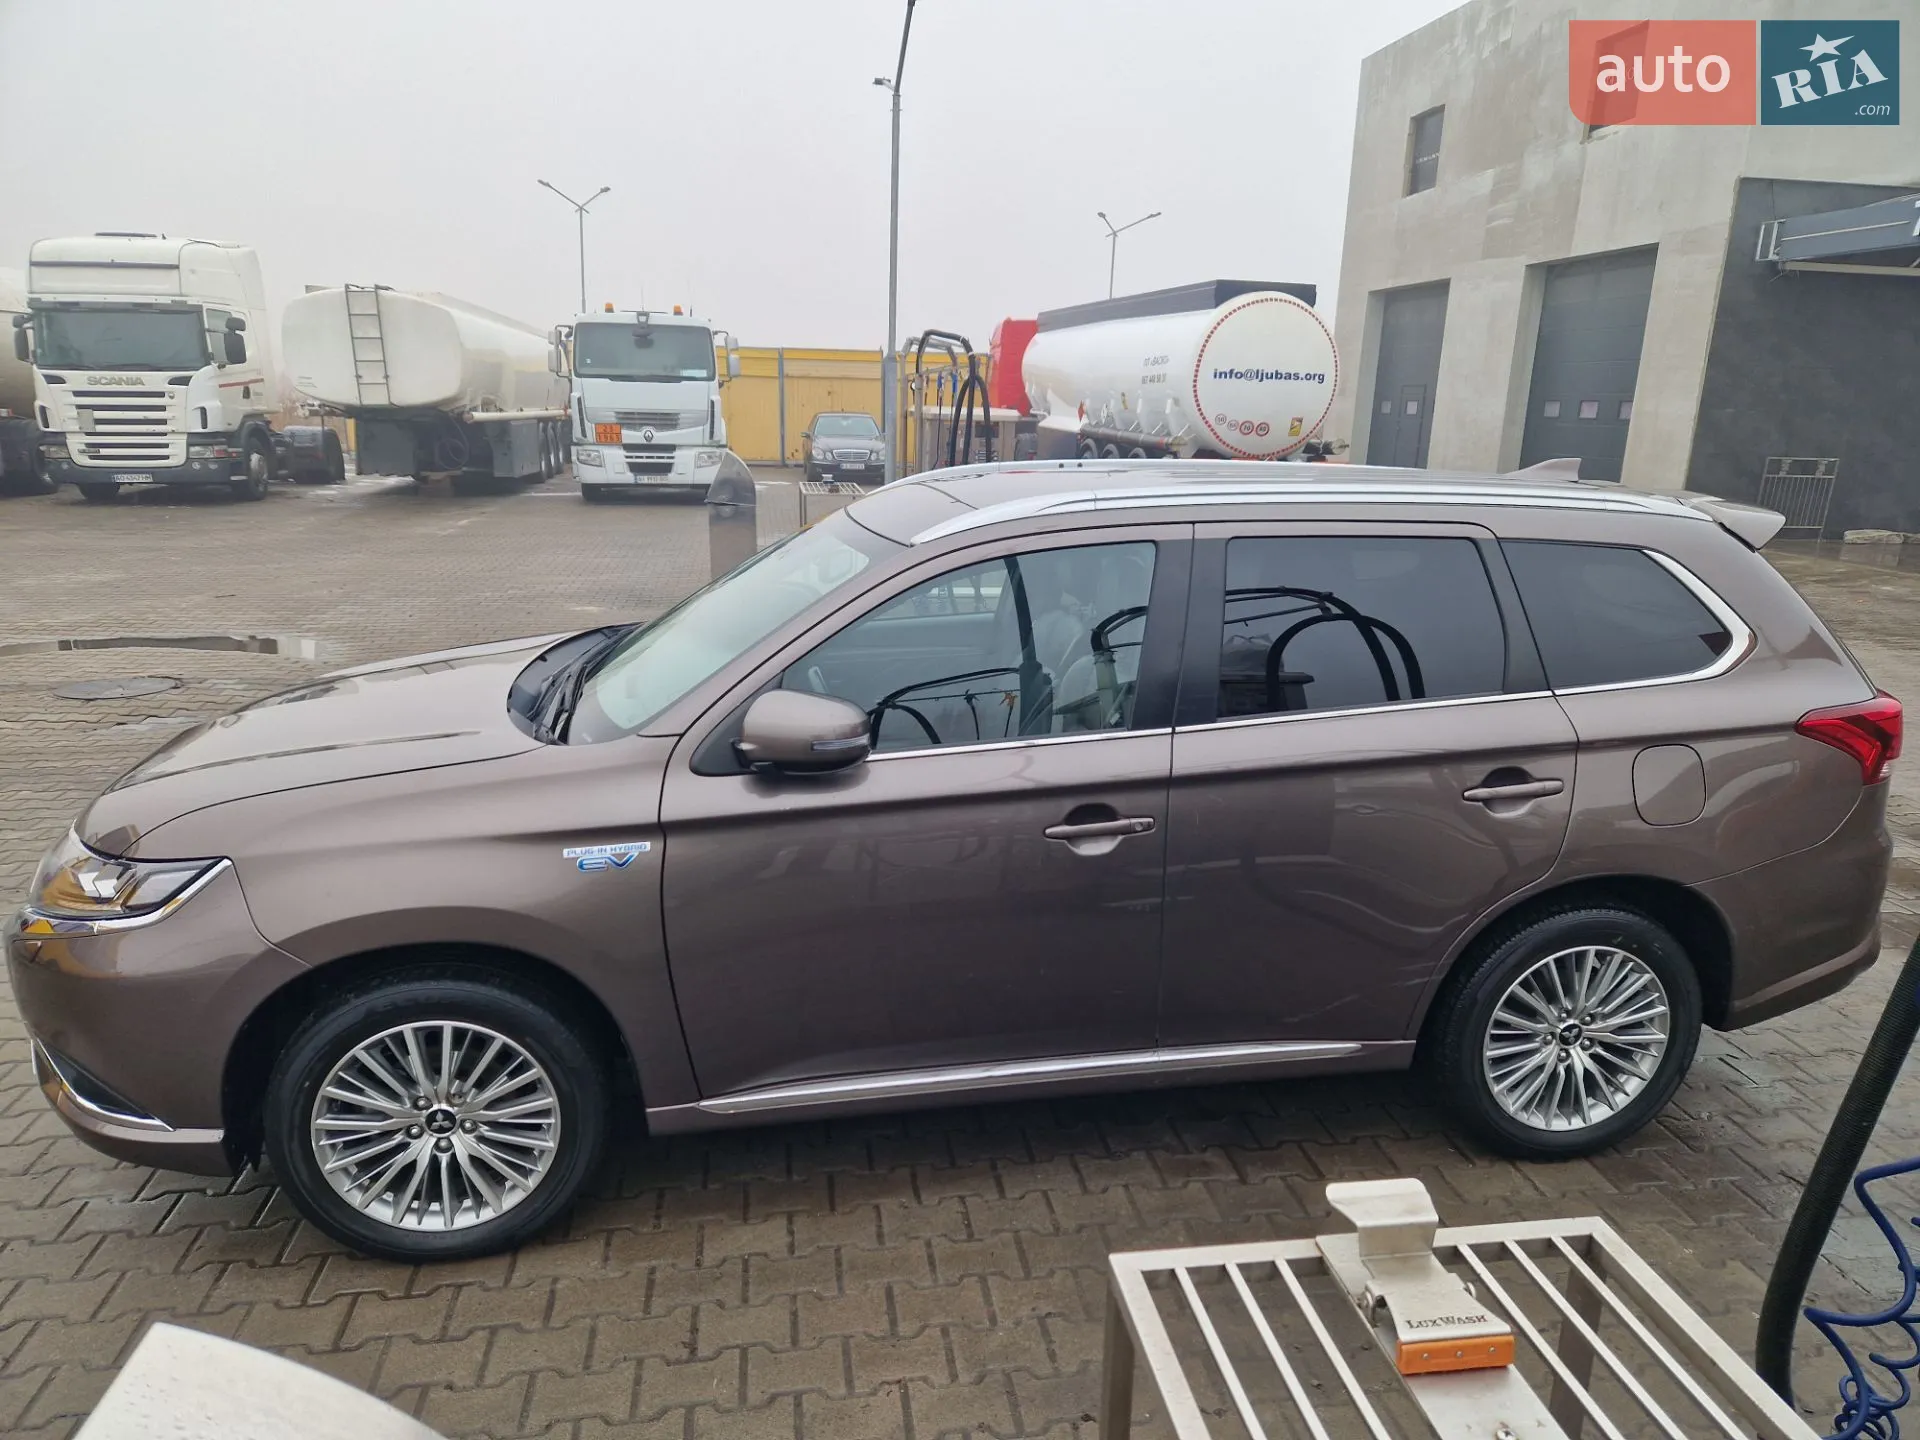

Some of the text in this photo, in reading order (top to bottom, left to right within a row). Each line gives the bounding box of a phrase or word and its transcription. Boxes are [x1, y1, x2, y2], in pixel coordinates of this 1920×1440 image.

[86, 375, 146, 386] SCANIA
[1213, 368, 1325, 384] info@ljubas.org
[610, 843, 648, 853] HYBRID
[577, 851, 640, 872] EV
